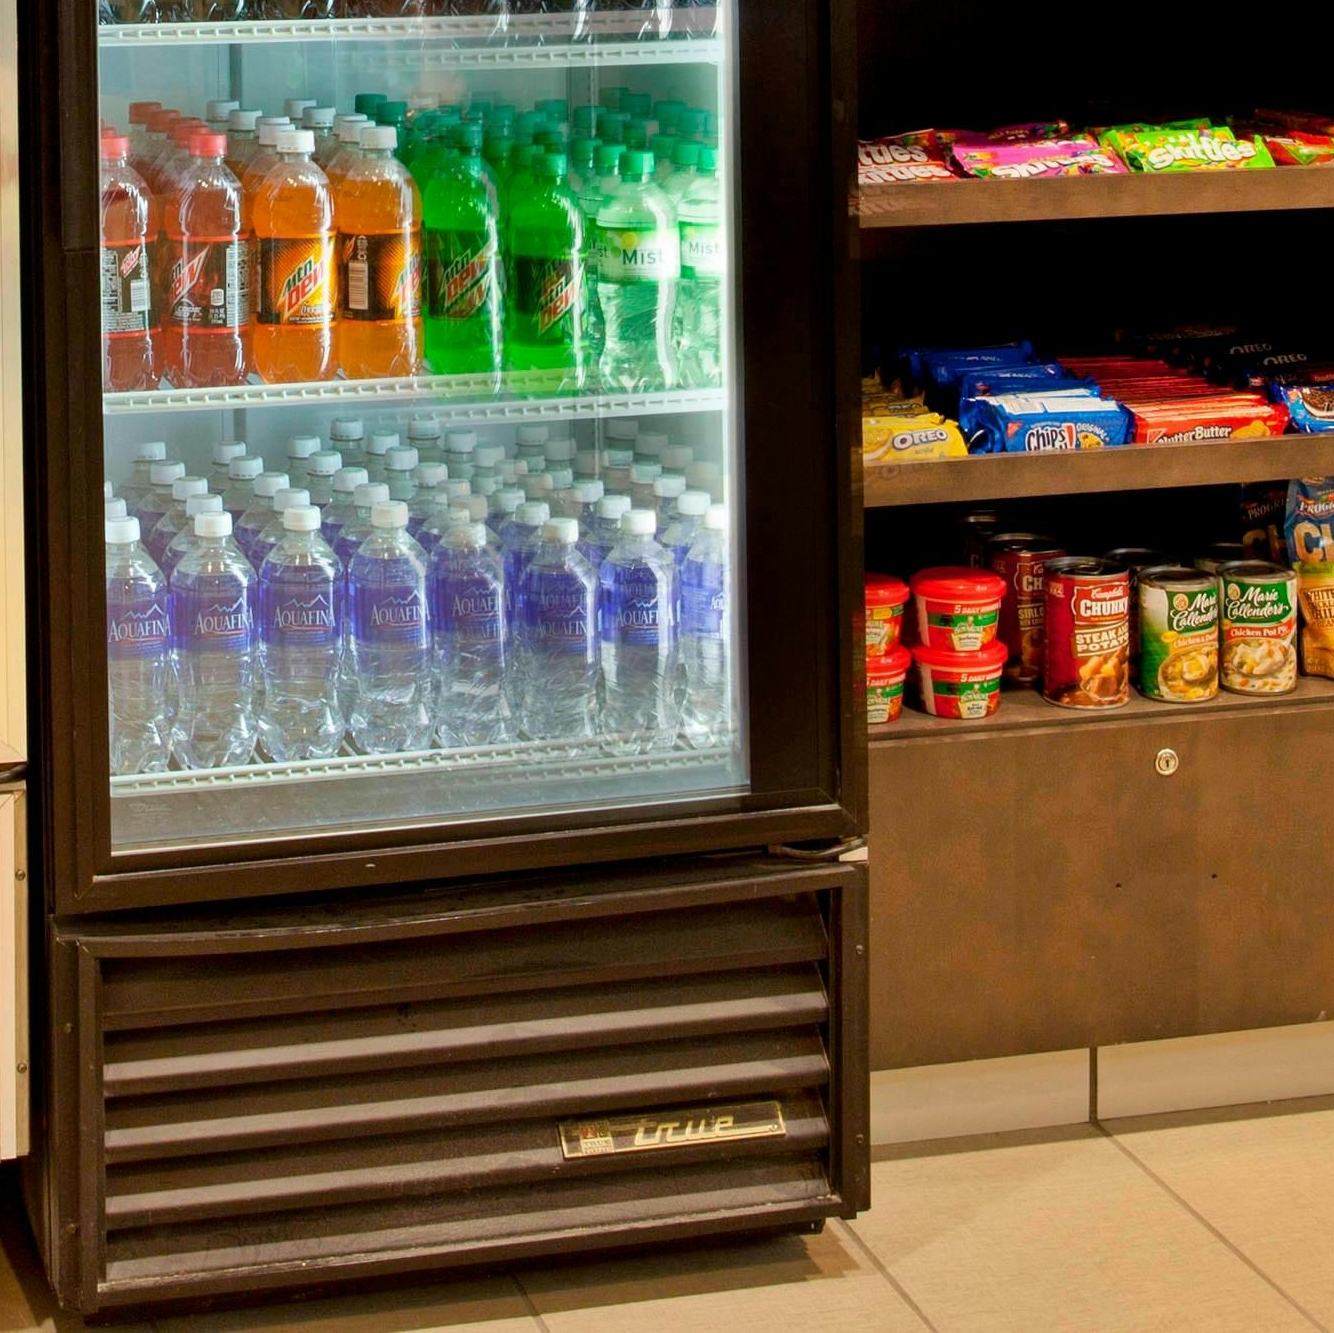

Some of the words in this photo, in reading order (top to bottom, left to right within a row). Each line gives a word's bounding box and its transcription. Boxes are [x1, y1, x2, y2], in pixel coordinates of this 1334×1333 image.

[1147, 133, 1257, 170] Skittles
[1263, 353, 1307, 365] OREO
[892, 428, 948, 451] OREO
[1025, 425, 1067, 451] Chips
[1195, 425, 1232, 440] Butter
[1239, 586, 1279, 606] Marie
[274, 605, 336, 628] AQUAFINA
[954, 605, 961, 614] 5
[108, 614, 171, 642] AQUAFINA
[194, 607, 254, 634] AQUAFINA
[1076, 630, 1117, 644] STEAK
[1230, 628, 1261, 638] Chicken
[1263, 628, 1276, 637] Pot
[961, 674, 967, 682] 5
